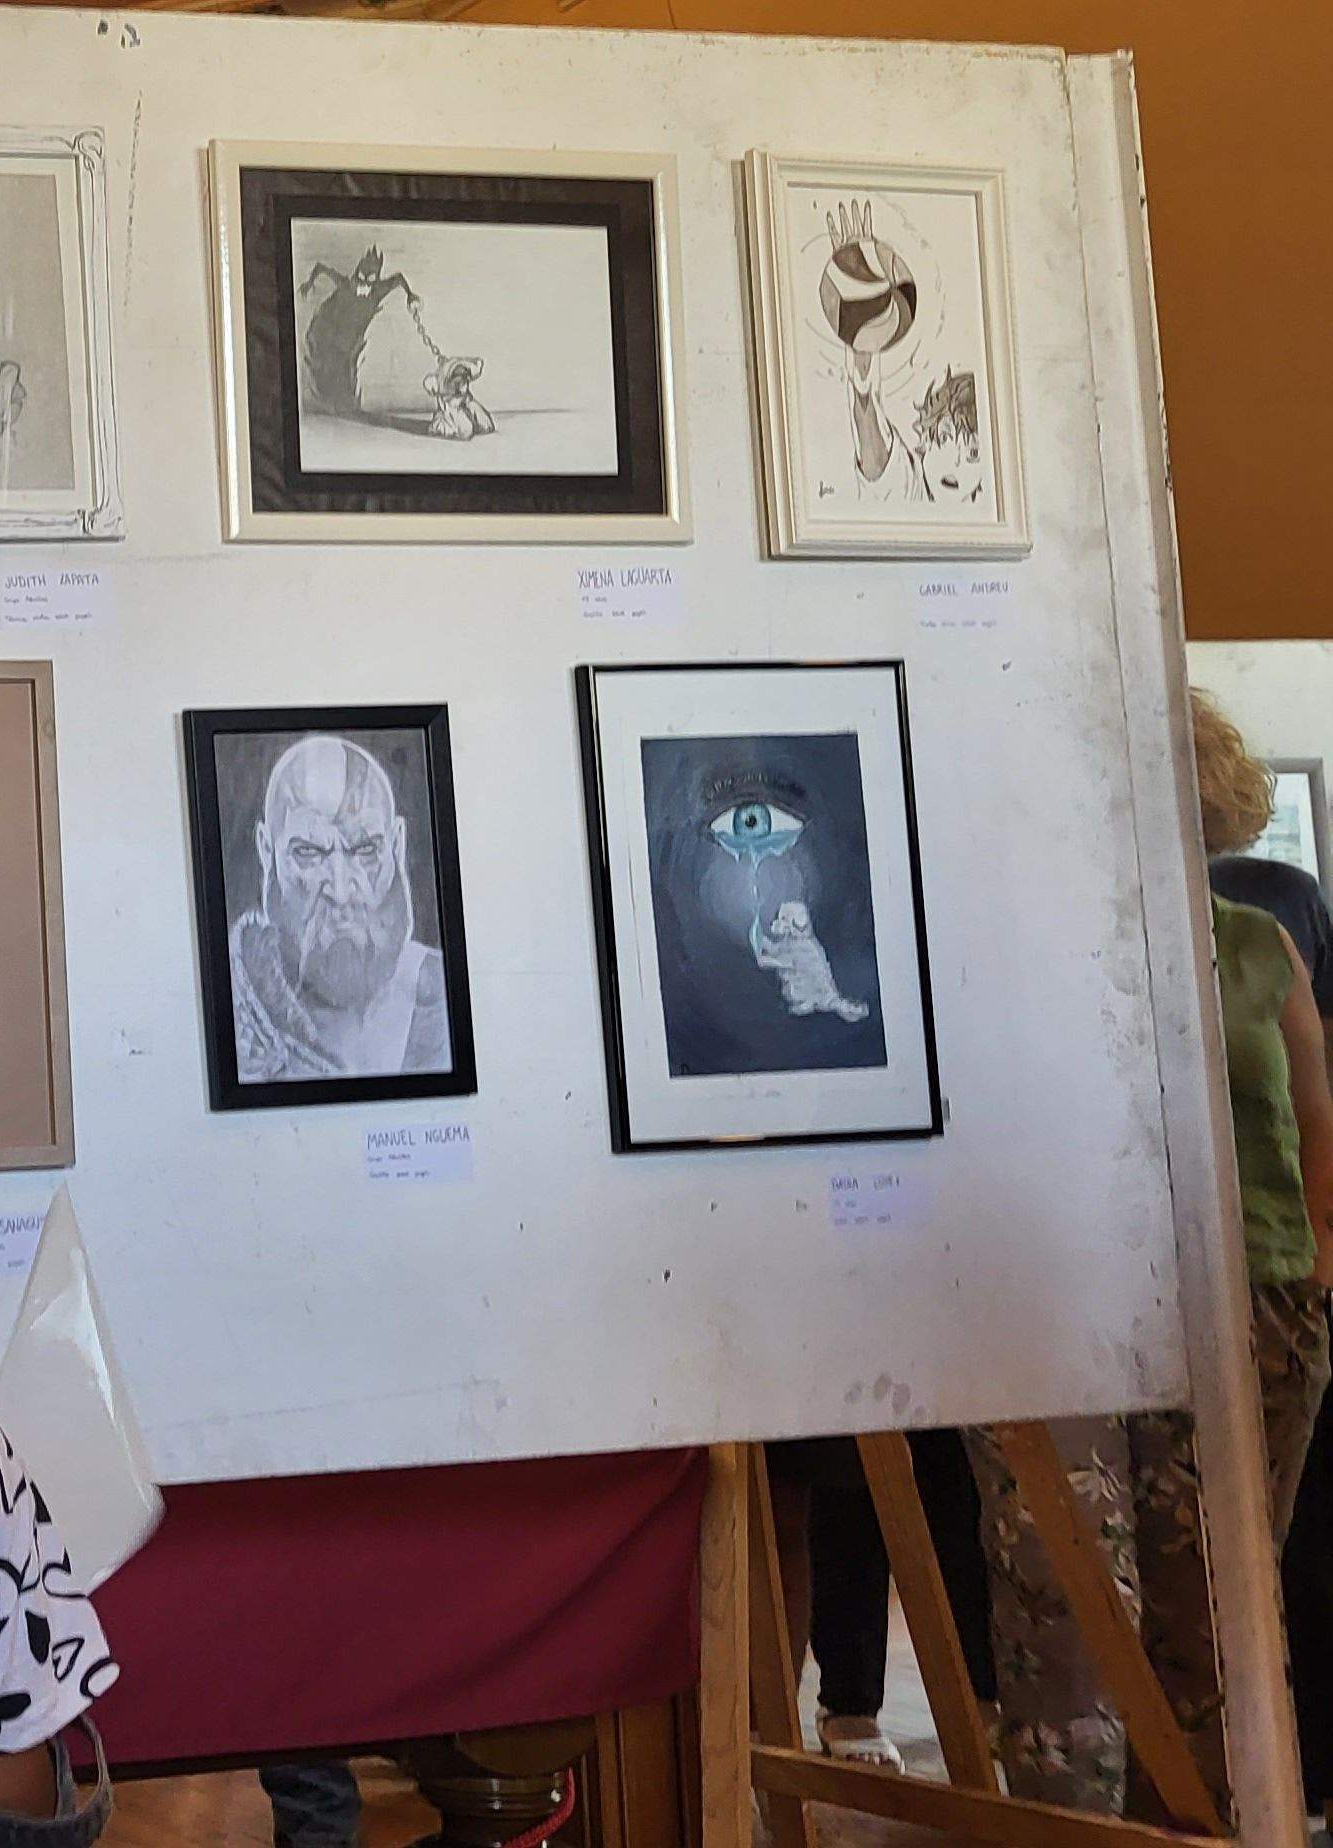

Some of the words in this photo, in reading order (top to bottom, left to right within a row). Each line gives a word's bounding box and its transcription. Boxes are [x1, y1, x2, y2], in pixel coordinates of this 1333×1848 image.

[4, 573, 47, 589] JUDITH
[577, 568, 615, 589] XIMENA
[367, 1128, 416, 1151] MANUEL
